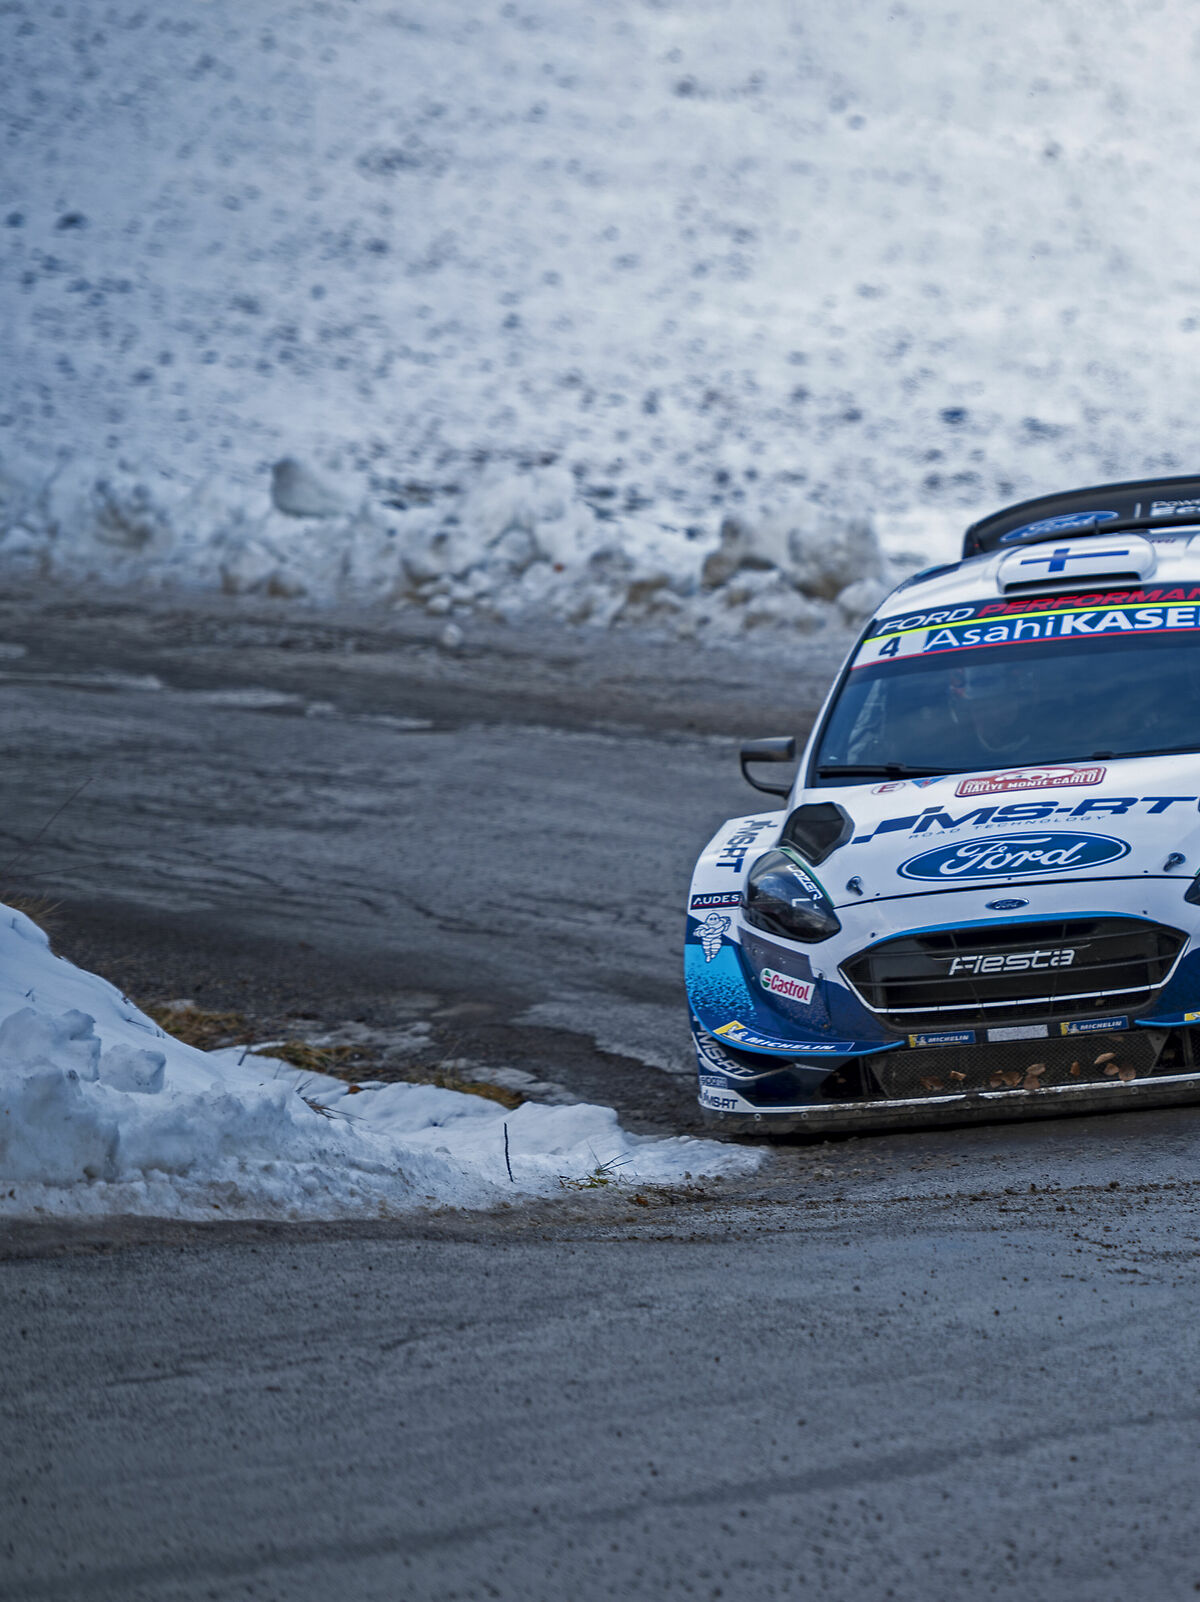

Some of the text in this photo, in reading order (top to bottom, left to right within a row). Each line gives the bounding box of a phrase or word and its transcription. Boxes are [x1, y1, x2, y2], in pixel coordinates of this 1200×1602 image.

[876, 608, 976, 636] FORD
[878, 637, 902, 657] 4
[962, 783, 1003, 794] RALLYE
[1007, 779, 1048, 789] MONTE
[1053, 771, 1098, 784] CARLO
[912, 797, 1198, 833] MS-RT
[908, 815, 1106, 840] ROAD TECHNOLOGY
[939, 836, 1088, 875] Ford
[693, 894, 740, 906] AUDES
[949, 950, 1076, 976] Fiesta
[770, 974, 811, 1001] Castrol
[1079, 1020, 1123, 1031] MICHELIN
[746, 1037, 836, 1050] MICHELIN
[927, 1034, 970, 1043] MICHELIN
